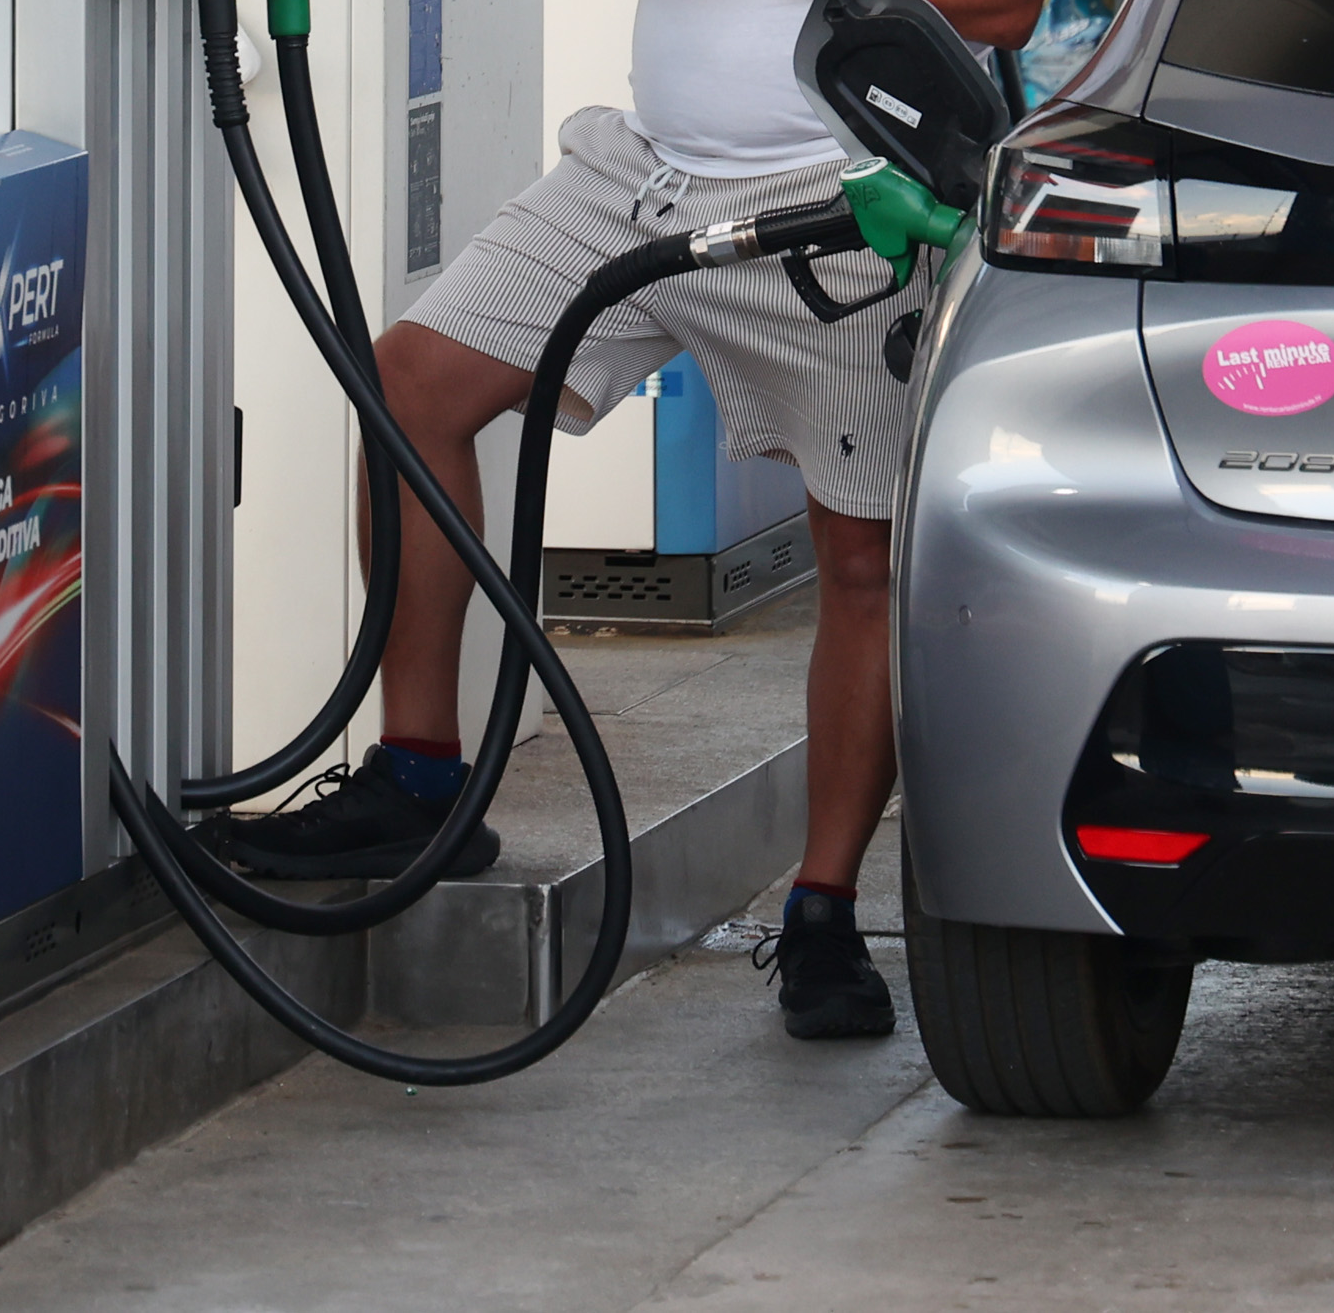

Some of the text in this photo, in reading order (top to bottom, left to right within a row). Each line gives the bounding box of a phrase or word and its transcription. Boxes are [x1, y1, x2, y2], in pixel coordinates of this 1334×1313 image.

[28, 324, 60, 346] FORMULA
[1217, 340, 1331, 366] Last minute
[1267, 352, 1331, 369] RENT A CAR
